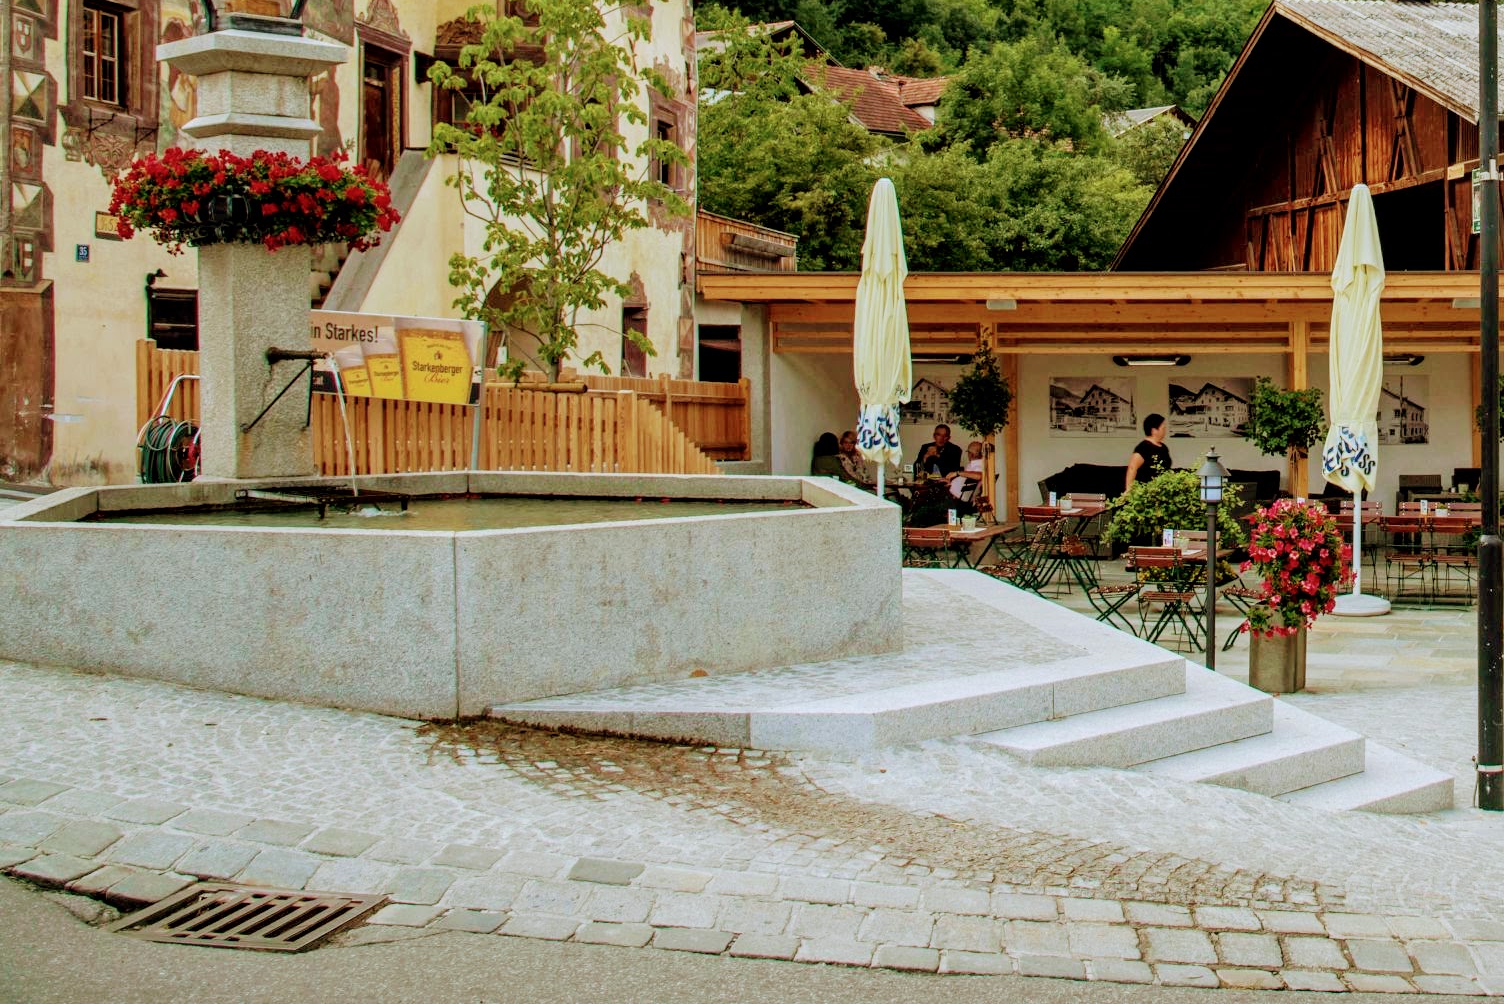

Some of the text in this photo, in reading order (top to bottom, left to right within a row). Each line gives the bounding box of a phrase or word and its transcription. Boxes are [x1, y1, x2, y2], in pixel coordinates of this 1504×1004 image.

[311, 321, 379, 343] in Starkes!
[412, 361, 463, 376] Starkenberger
